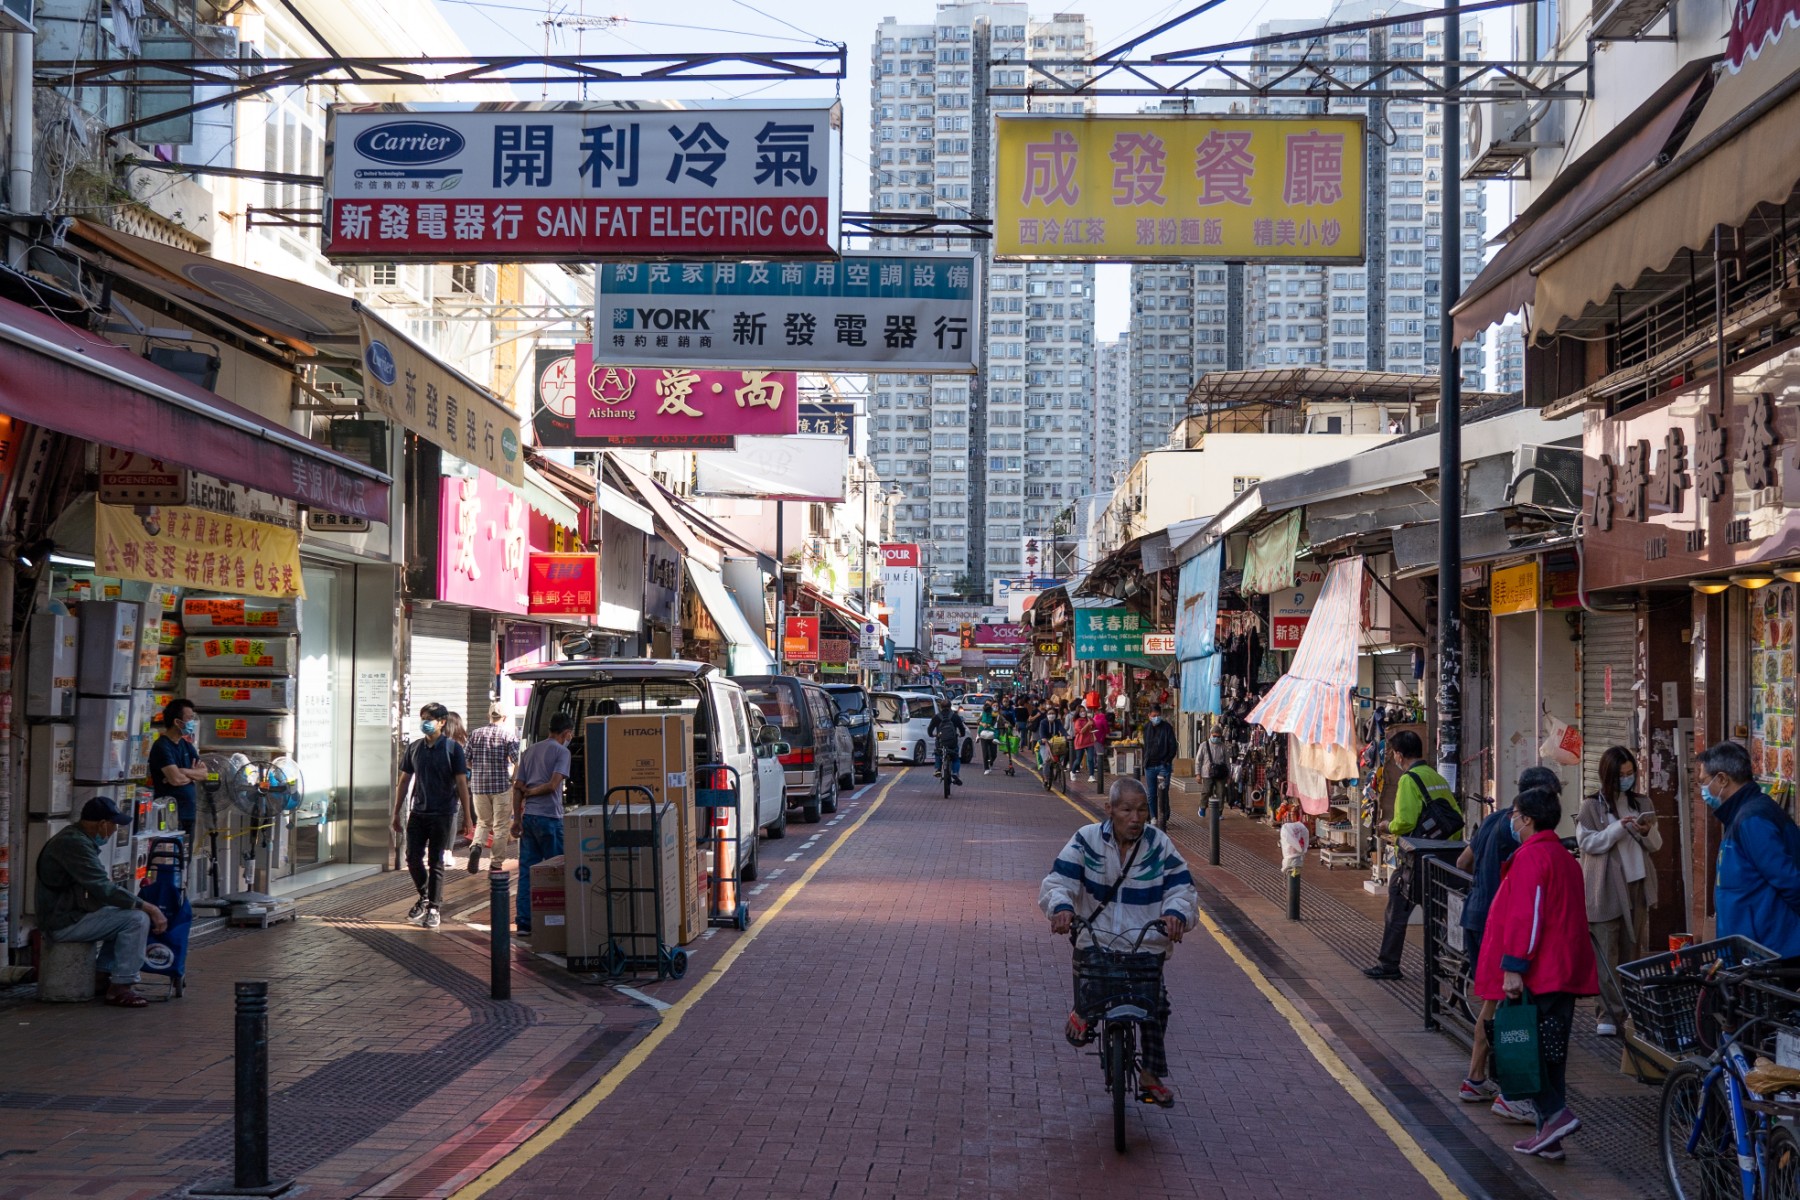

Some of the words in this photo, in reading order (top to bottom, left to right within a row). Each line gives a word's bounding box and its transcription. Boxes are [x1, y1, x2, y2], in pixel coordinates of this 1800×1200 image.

[370, 132, 450, 151] Carrier
[492, 121, 818, 188] 開利冷氣
[1021, 129, 1345, 207] 成發餐廳
[354, 180, 435, 190] 你信賴的專家
[340, 204, 523, 240] 新發電器行
[536, 205, 587, 237] SAN
[595, 206, 643, 237] FAT
[650, 205, 773, 237] ELECTRIC
[781, 204, 824, 236] CO.
[1019, 218, 1105, 245] 西冷紅茶
[1136, 218, 1222, 245] 粥粉麵飯
[1253, 218, 1341, 246] 精美小炒
[615, 262, 969, 289] 約克家用及商用空調設備
[637, 308, 711, 330] YORK
[613, 335, 712, 348] 特約經銷商
[732, 312, 968, 350] 新發電器行
[405, 367, 495, 462] 新發電器行
[588, 407, 636, 420] Aishang
[118, 477, 172, 485] GENERAL
[105, 532, 177, 580] 全部電器
[185, 548, 246, 589] 特價發售
[252, 560, 299, 594] 包安裝
[547, 563, 583, 579] EMS
[531, 590, 592, 606] 直郵全國
[1088, 615, 1140, 632] 長春藤
[623, 728, 664, 736] HITACH
